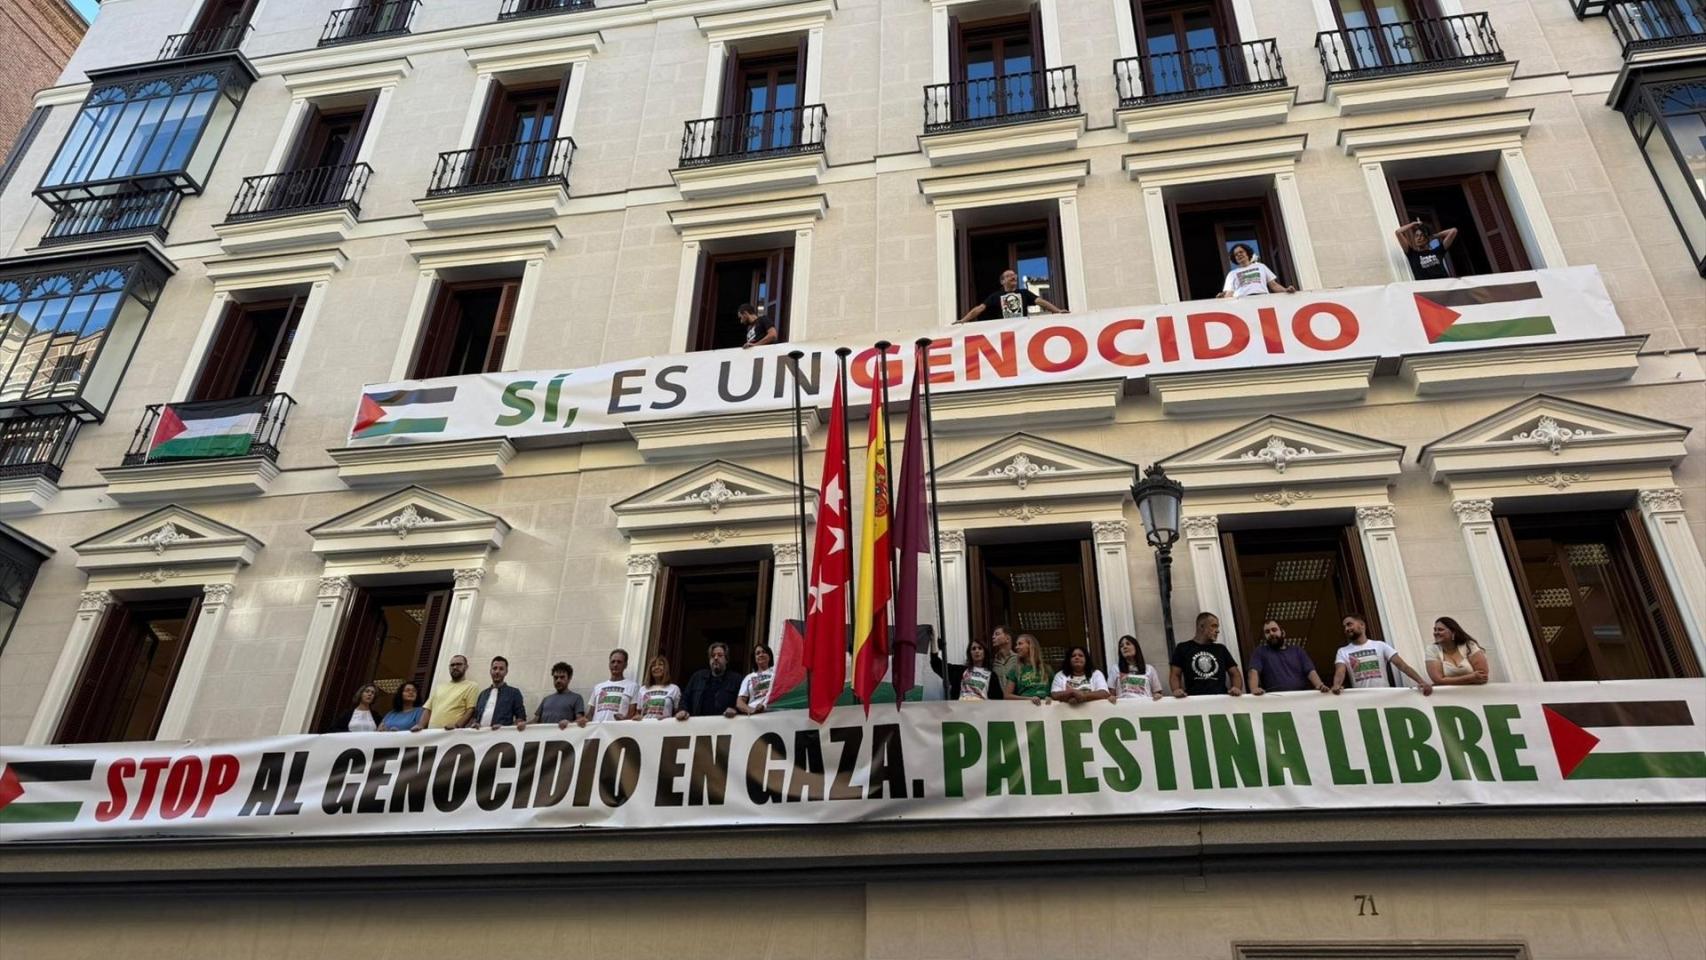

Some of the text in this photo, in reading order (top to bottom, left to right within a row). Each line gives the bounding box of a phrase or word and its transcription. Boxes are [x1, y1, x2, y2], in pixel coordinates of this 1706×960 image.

[495, 302, 1360, 430] SÍ, ES UN GENOCIDIO
[95, 703, 1539, 822] STOP AL GENOCIDIO EN GAZA. PALESTINA LIBRE
[1353, 894, 1380, 917] 71
